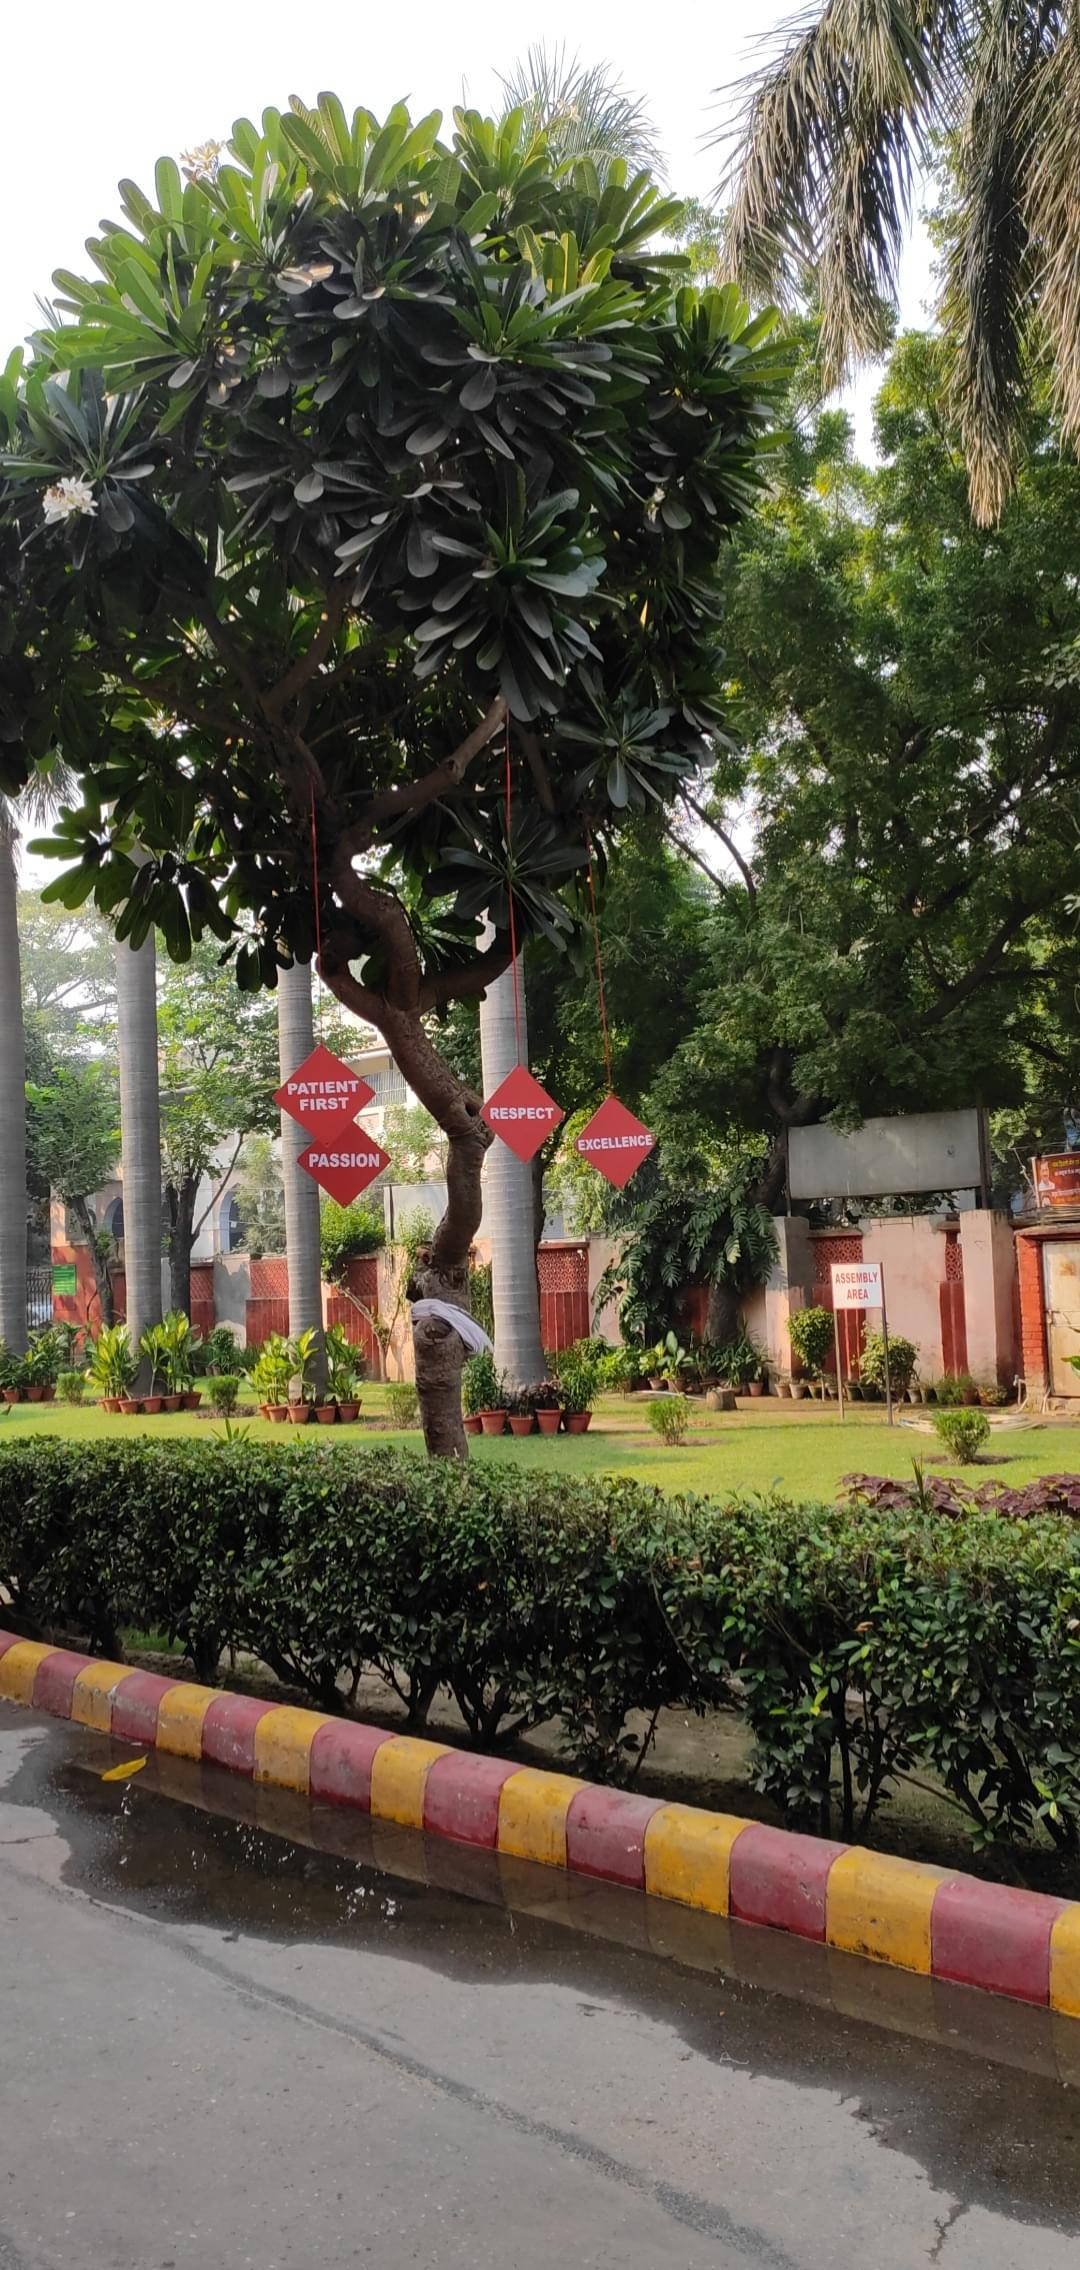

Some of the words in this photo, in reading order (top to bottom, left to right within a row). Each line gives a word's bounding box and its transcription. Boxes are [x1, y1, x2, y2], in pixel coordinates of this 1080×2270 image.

[287, 1080, 359, 1095] PATIENT
[299, 1097, 349, 1111] FIRST
[489, 1107, 554, 1120] RESPECT
[577, 1134, 654, 1151] EXCELLENCE
[308, 1153, 380, 1168] PASSION
[835, 1271, 878, 1284] ASSEMBLY
[847, 1288, 869, 1300] AREA
